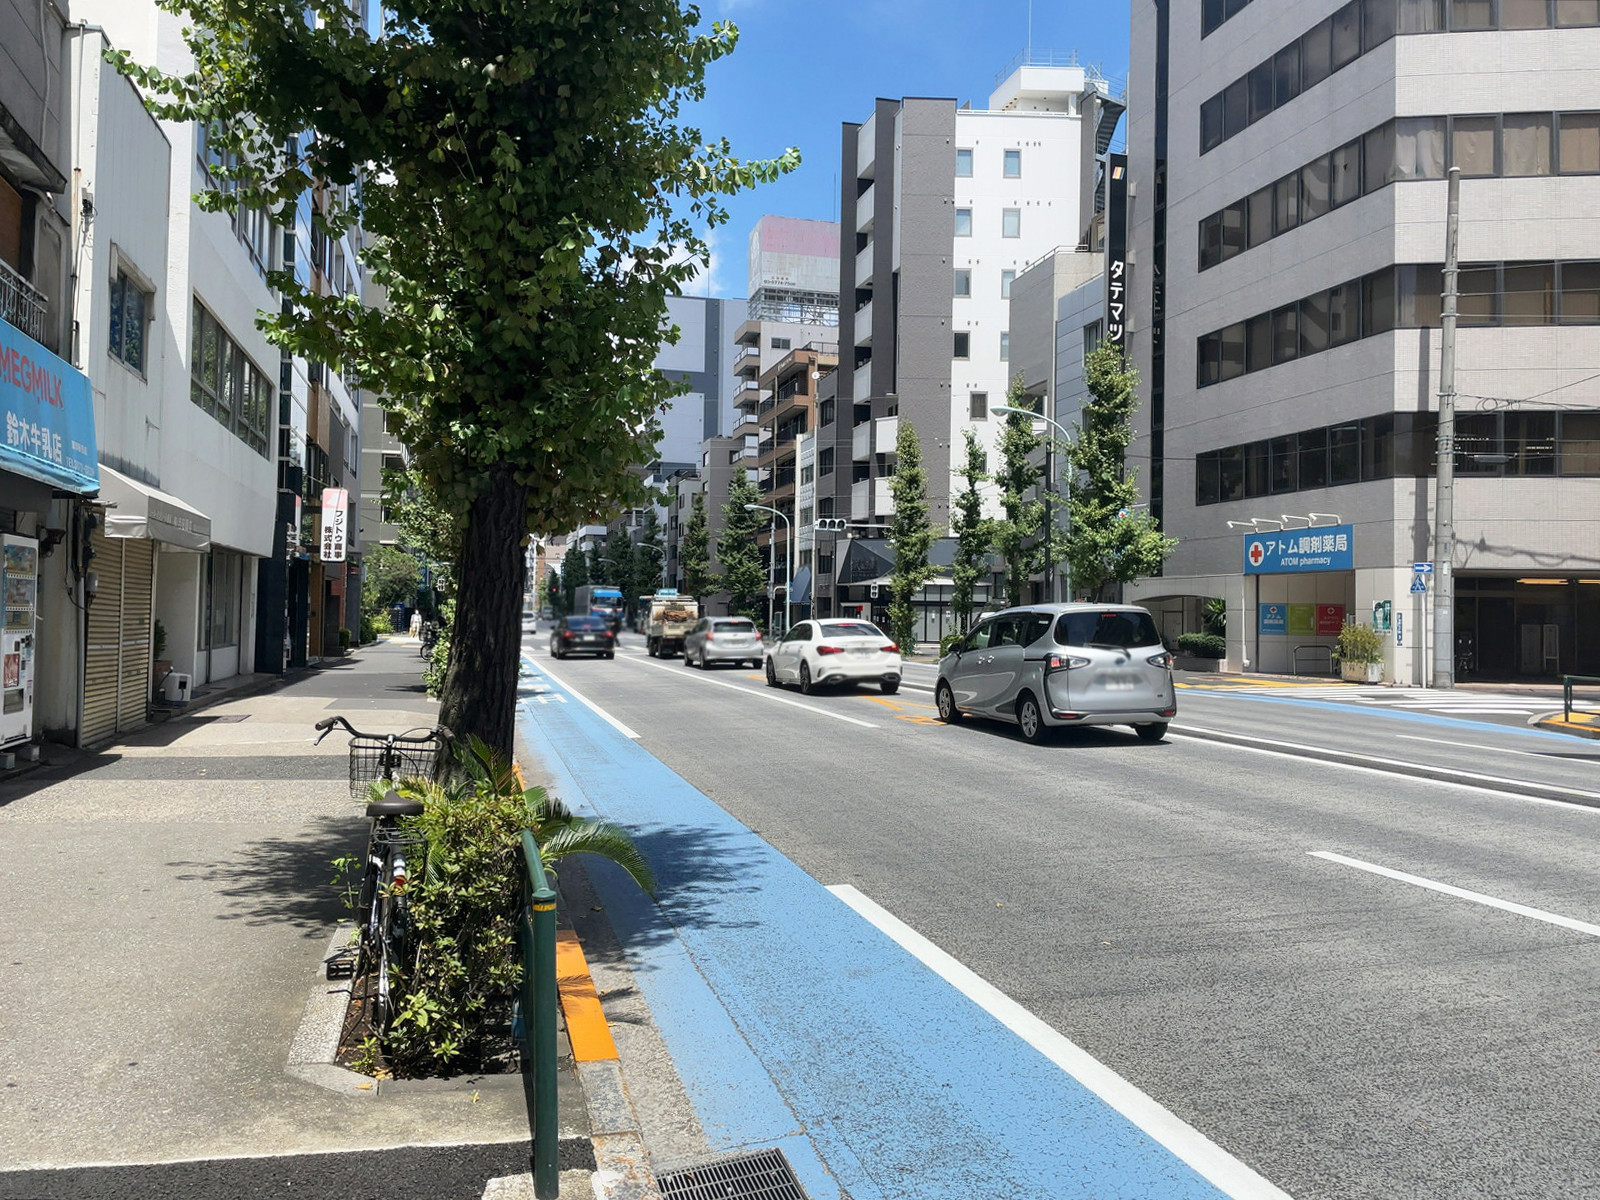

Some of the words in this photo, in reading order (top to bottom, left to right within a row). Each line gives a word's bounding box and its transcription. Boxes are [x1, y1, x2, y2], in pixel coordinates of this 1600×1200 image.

[1109, 260, 1124, 341] タテマツ
[0, 343, 63, 407] MEGMILK
[6, 410, 62, 464] 鈴木牛乳店
[324, 526, 333, 559] 株式会社
[334, 510, 343, 559] フジトウ商事
[1266, 534, 1348, 556] アトム調剤薬局
[1280, 557, 1299, 566] ATOM
[1299, 556, 1331, 567] pharmacy
